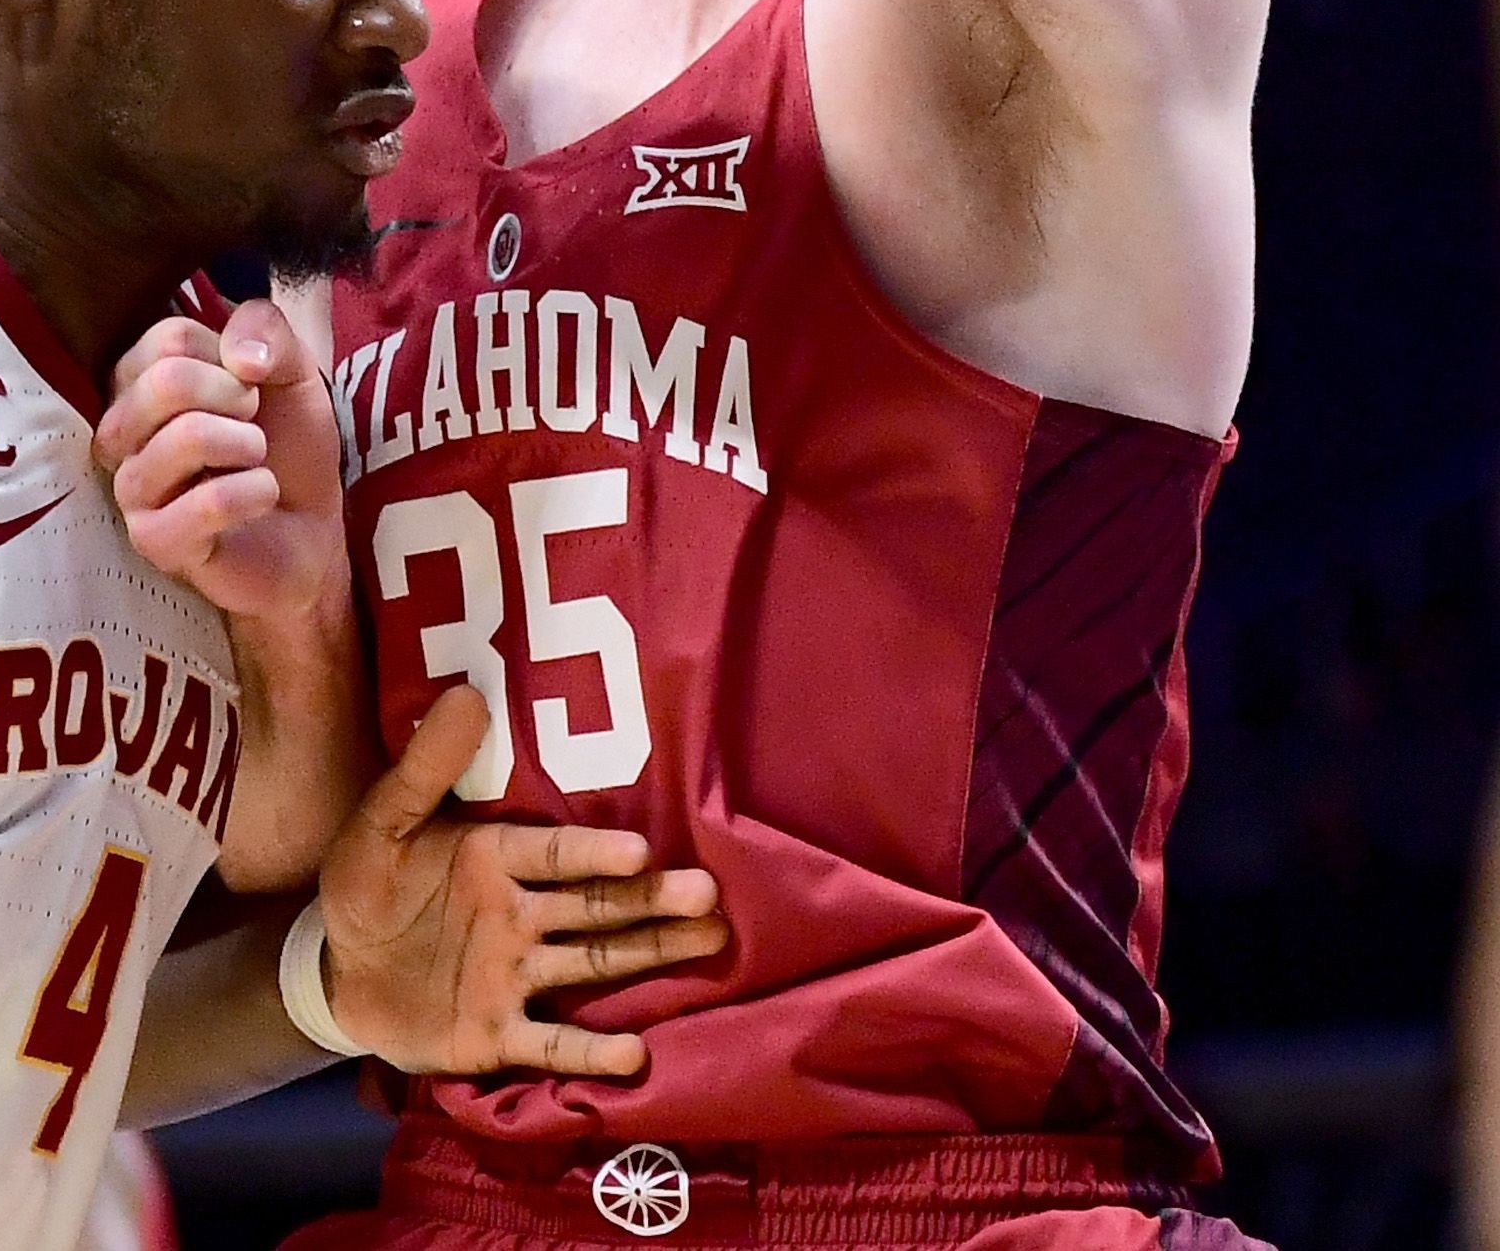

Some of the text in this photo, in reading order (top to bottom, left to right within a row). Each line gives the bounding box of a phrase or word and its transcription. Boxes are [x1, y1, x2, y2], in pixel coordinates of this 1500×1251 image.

[332, 289, 768, 495] KLAHOMA
[372, 467, 653, 801] 35
[16, 843, 150, 1156] 4
